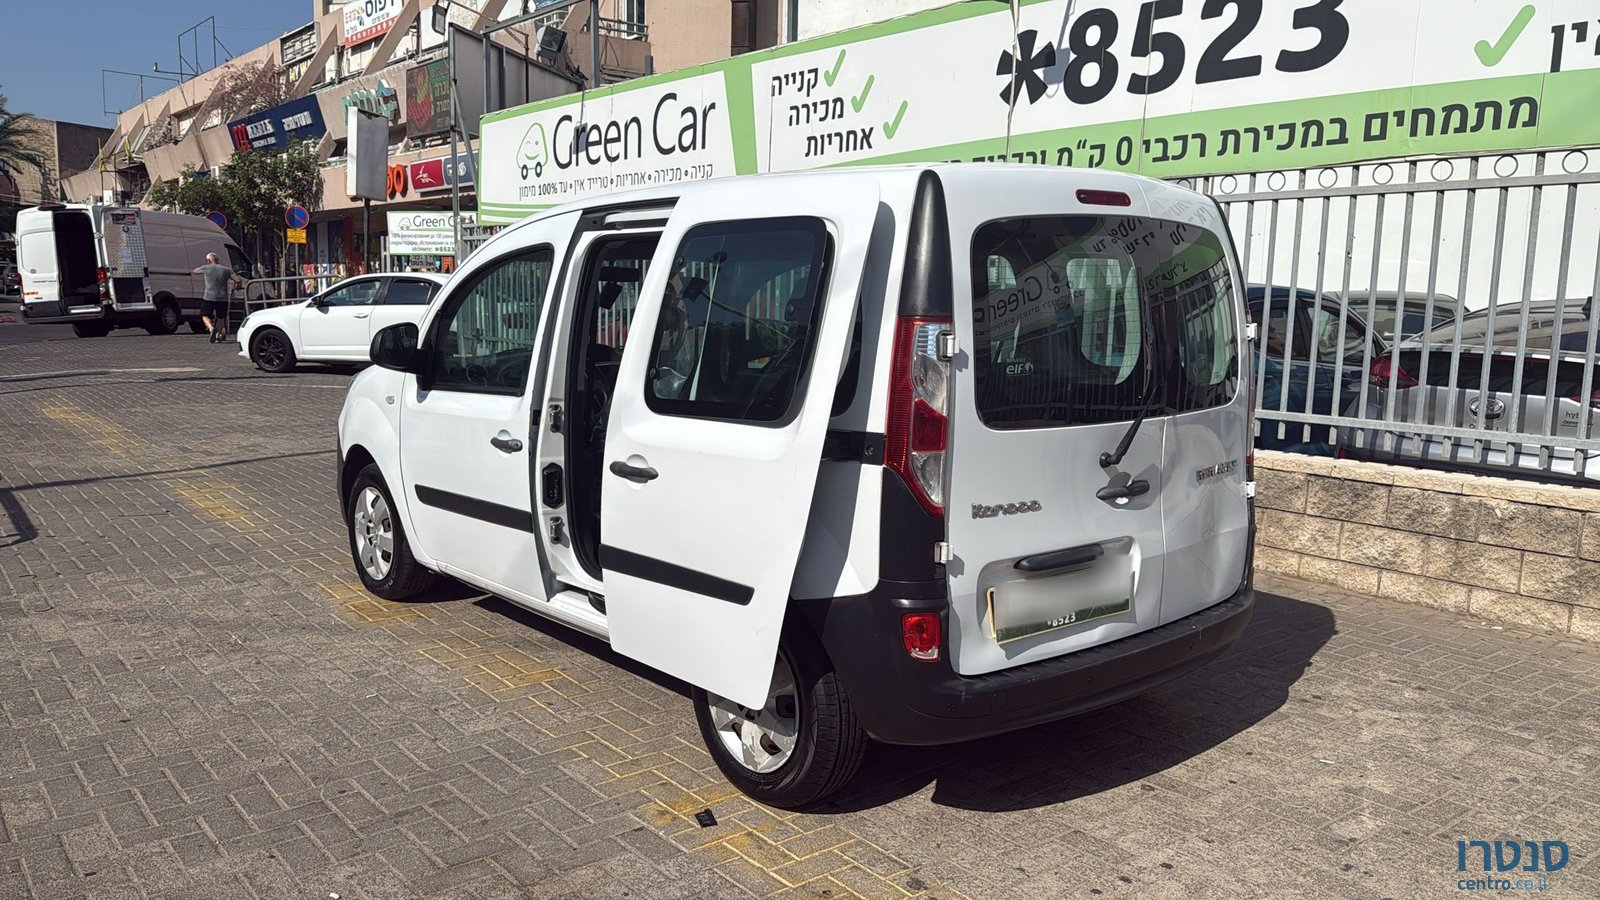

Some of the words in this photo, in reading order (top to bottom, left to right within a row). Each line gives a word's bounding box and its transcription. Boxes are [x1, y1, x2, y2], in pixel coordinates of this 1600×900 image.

[1549, 18, 1600, 73] ין
[771, 67, 818, 97] קנייה
[789, 97, 844, 126] מכירה
[1363, 96, 1538, 142] מתמחים
[553, 114, 642, 169] Green
[653, 92, 716, 156] Car
[1217, 116, 1348, 155] במכירת
[805, 127, 874, 157] אחריות
[1116, 136, 1133, 166] 0
[1142, 132, 1207, 163] רכבי
[615, 171, 646, 188] אחריות
[654, 167, 682, 183] מכירה
[690, 163, 713, 181] קניה
[538, 183, 557, 196] 100%
[559, 182, 568, 193] עד
[574, 178, 585, 195] אין
[587, 175, 608, 189] טרייד
[519, 185, 536, 201] מימון
[413, 215, 445, 227] Green
[1006, 363, 1024, 374] elf
